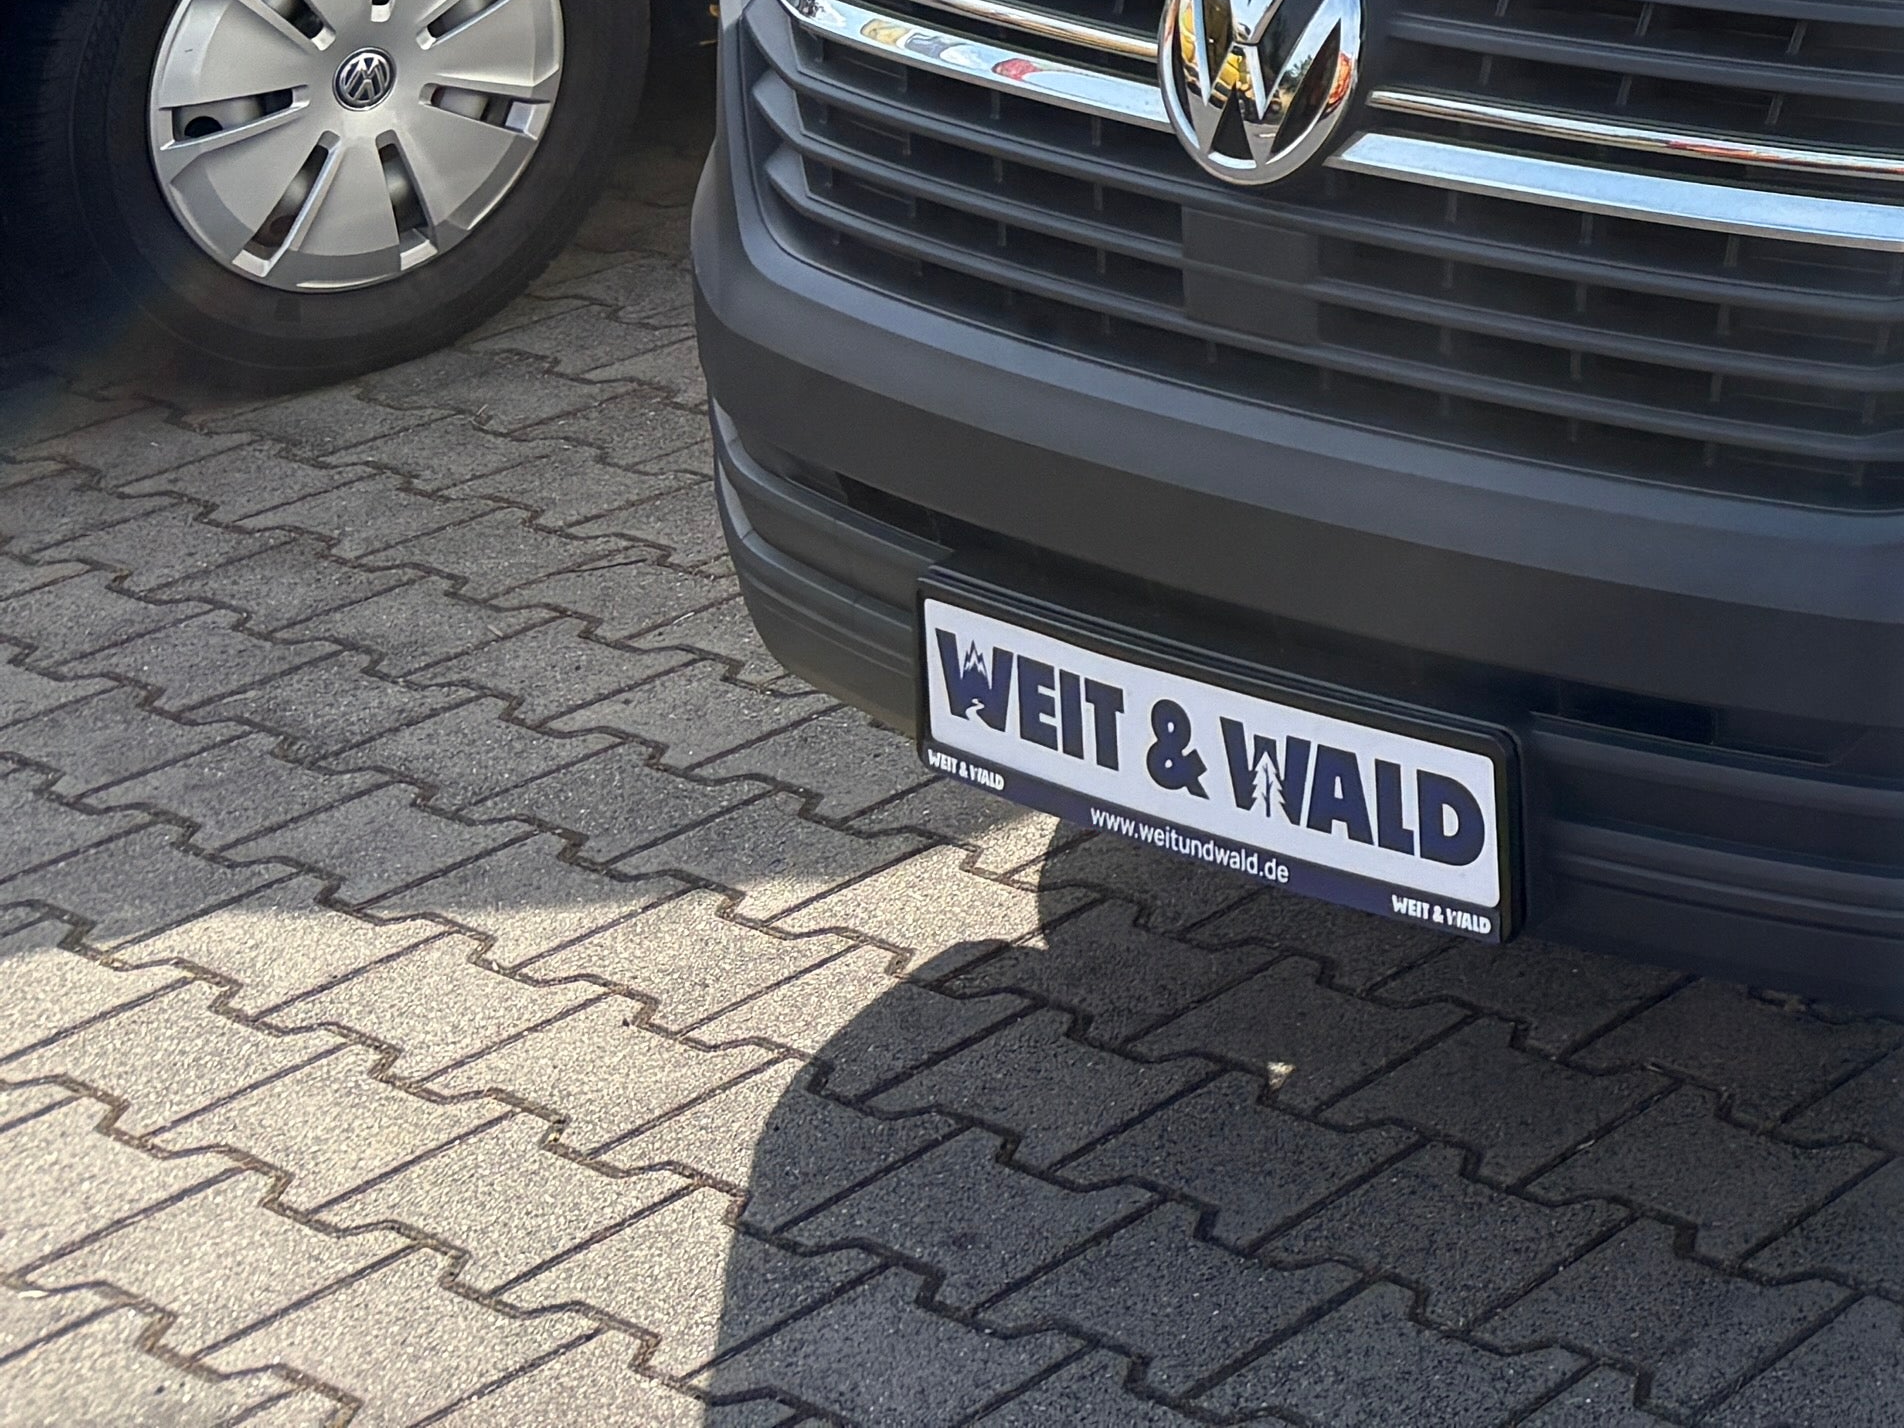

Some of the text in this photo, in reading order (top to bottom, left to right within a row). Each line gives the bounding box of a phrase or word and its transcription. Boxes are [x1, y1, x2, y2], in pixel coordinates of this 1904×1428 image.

[928, 748, 1005, 791] WEIT & WALD
[935, 627, 1486, 867] WEIT & WALD
[1090, 807, 1290, 883] www.weitundwald.de
[1391, 894, 1492, 934] WEIT & WALD
